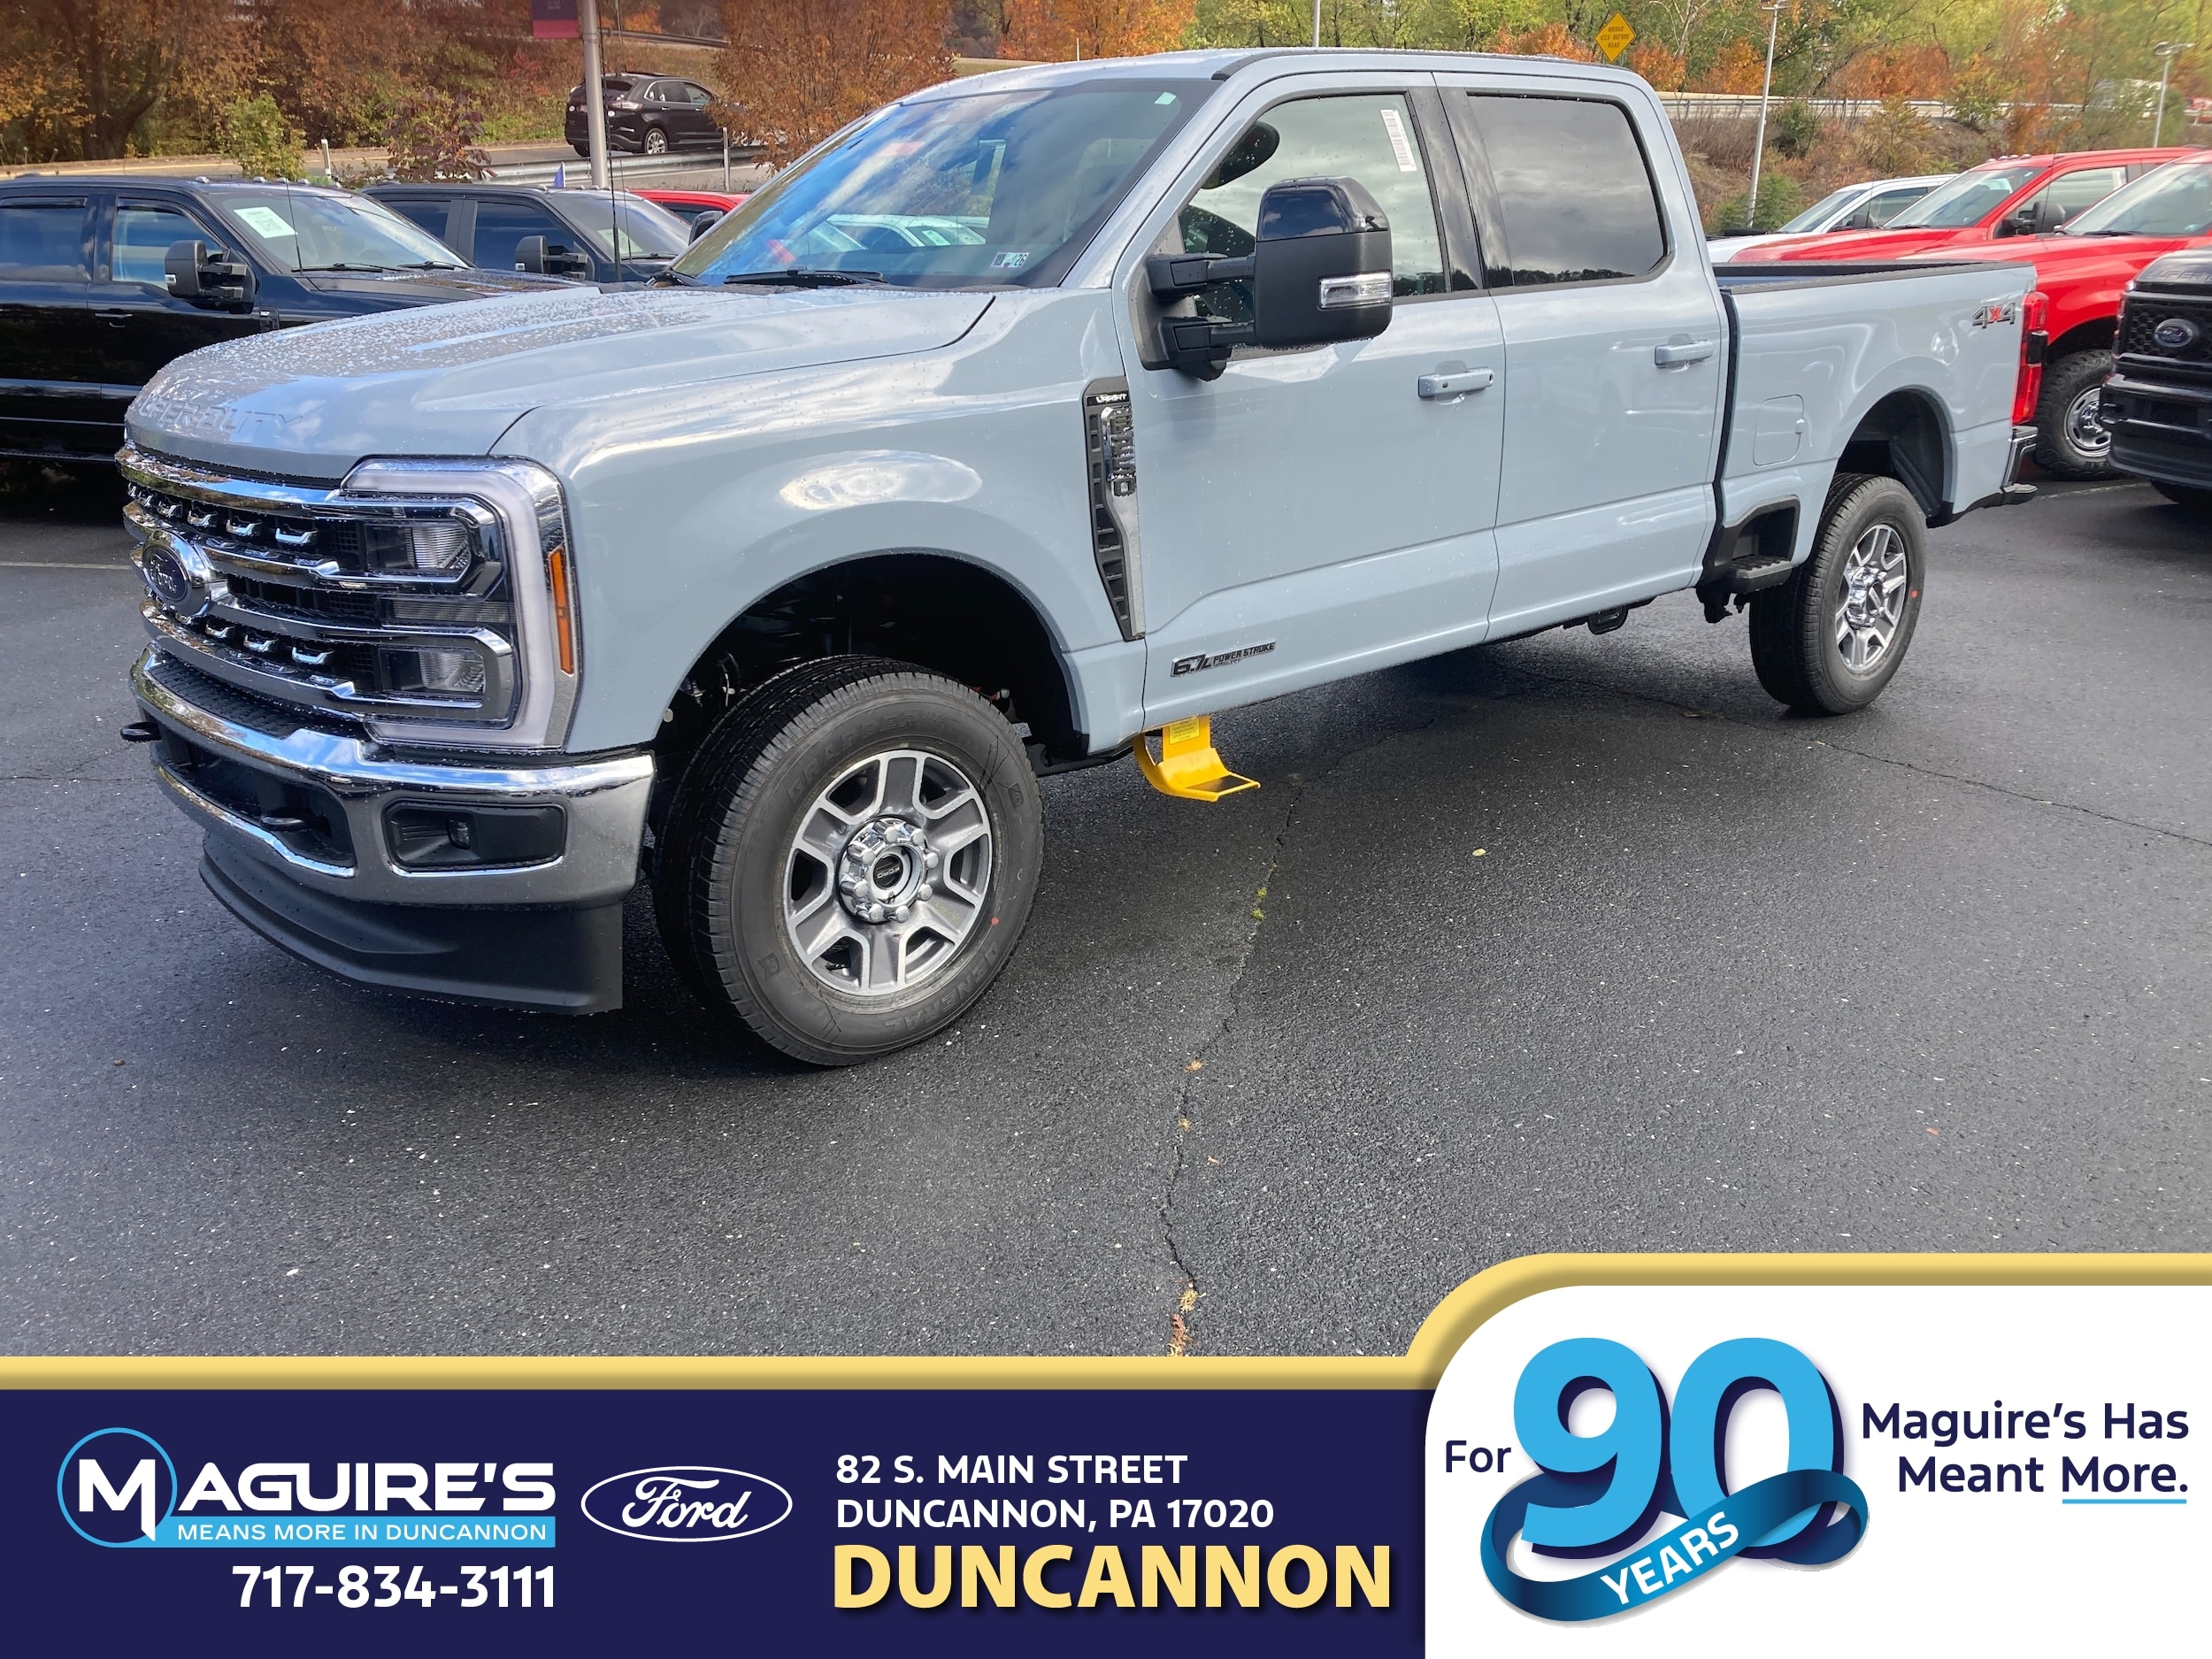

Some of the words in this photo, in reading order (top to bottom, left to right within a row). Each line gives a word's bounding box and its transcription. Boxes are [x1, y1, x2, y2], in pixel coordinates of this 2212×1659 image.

[1213, 649, 1243, 664] POWER
[1242, 641, 1276, 657] STROKE
[884, 941, 1000, 1035] GENERAL
